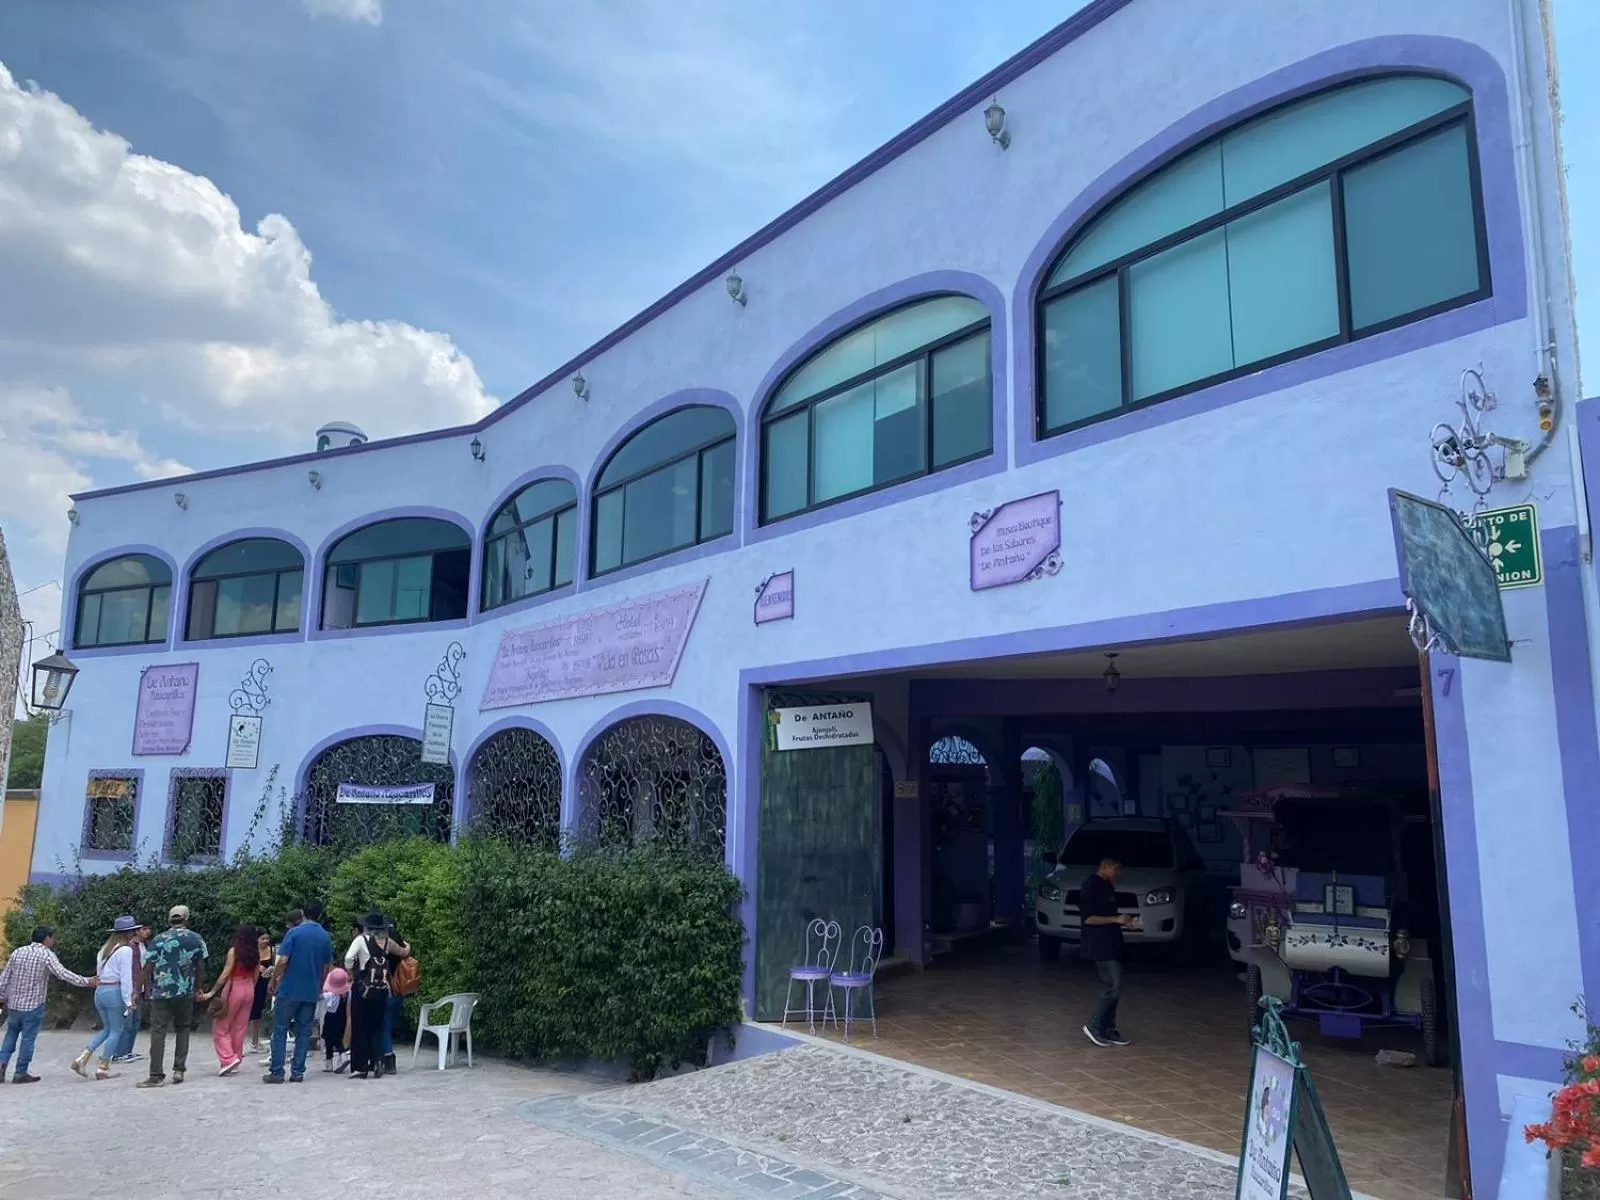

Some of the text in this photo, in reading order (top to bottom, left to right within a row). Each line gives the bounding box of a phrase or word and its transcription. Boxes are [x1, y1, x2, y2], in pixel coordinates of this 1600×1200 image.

[1510, 511, 1527, 522] DE
[1497, 569, 1532, 582] NION
[1437, 668, 1456, 697] 7
[794, 709, 854, 722] De ANTAÑO
[792, 731, 859, 742] Frutas Deshidratadas
